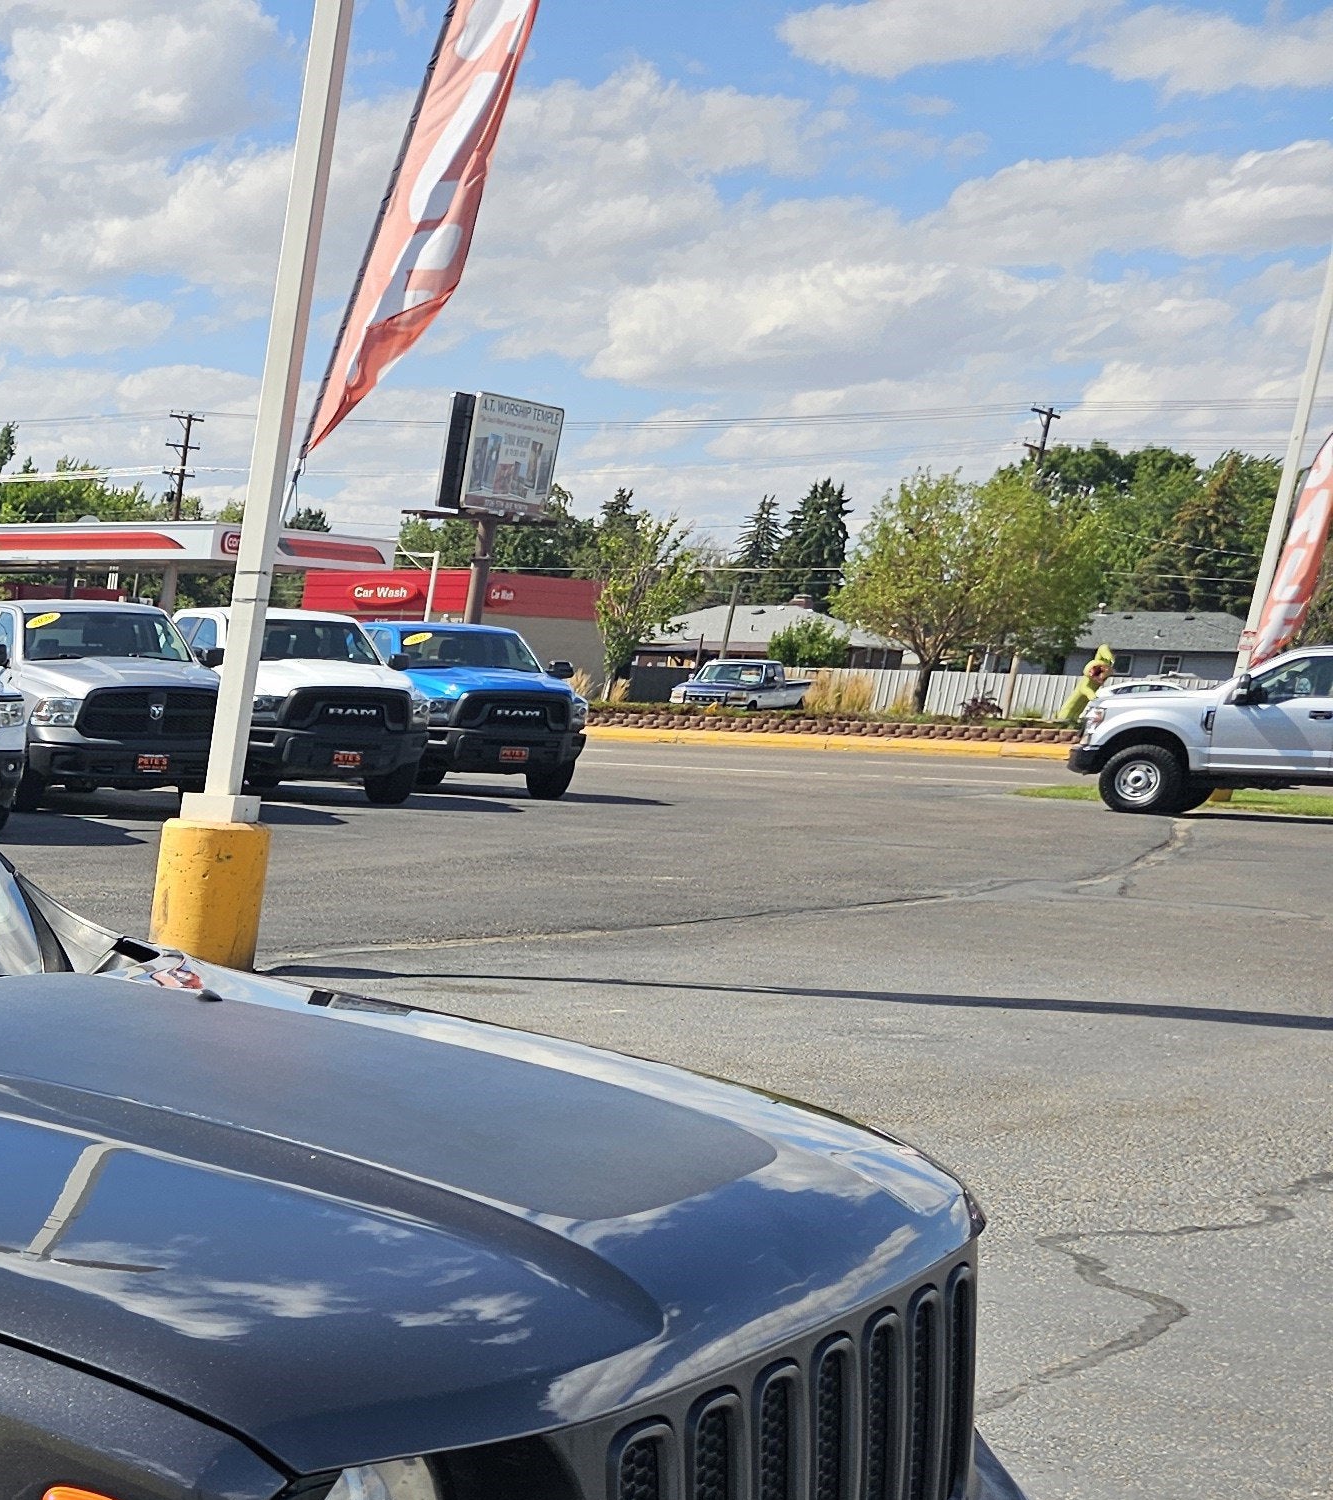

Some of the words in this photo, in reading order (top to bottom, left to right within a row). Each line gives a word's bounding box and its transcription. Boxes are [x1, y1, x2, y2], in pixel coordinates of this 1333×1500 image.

[497, 401, 532, 419] WORSHIP
[533, 408, 560, 426] TEMPLE
[354, 586, 375, 598] Car
[376, 586, 408, 598] Wash
[490, 588, 500, 600] Car
[500, 589, 515, 601] Wash
[328, 708, 377, 716] RAM
[496, 709, 541, 717] RAM
[138, 757, 168, 765] PETE'S
